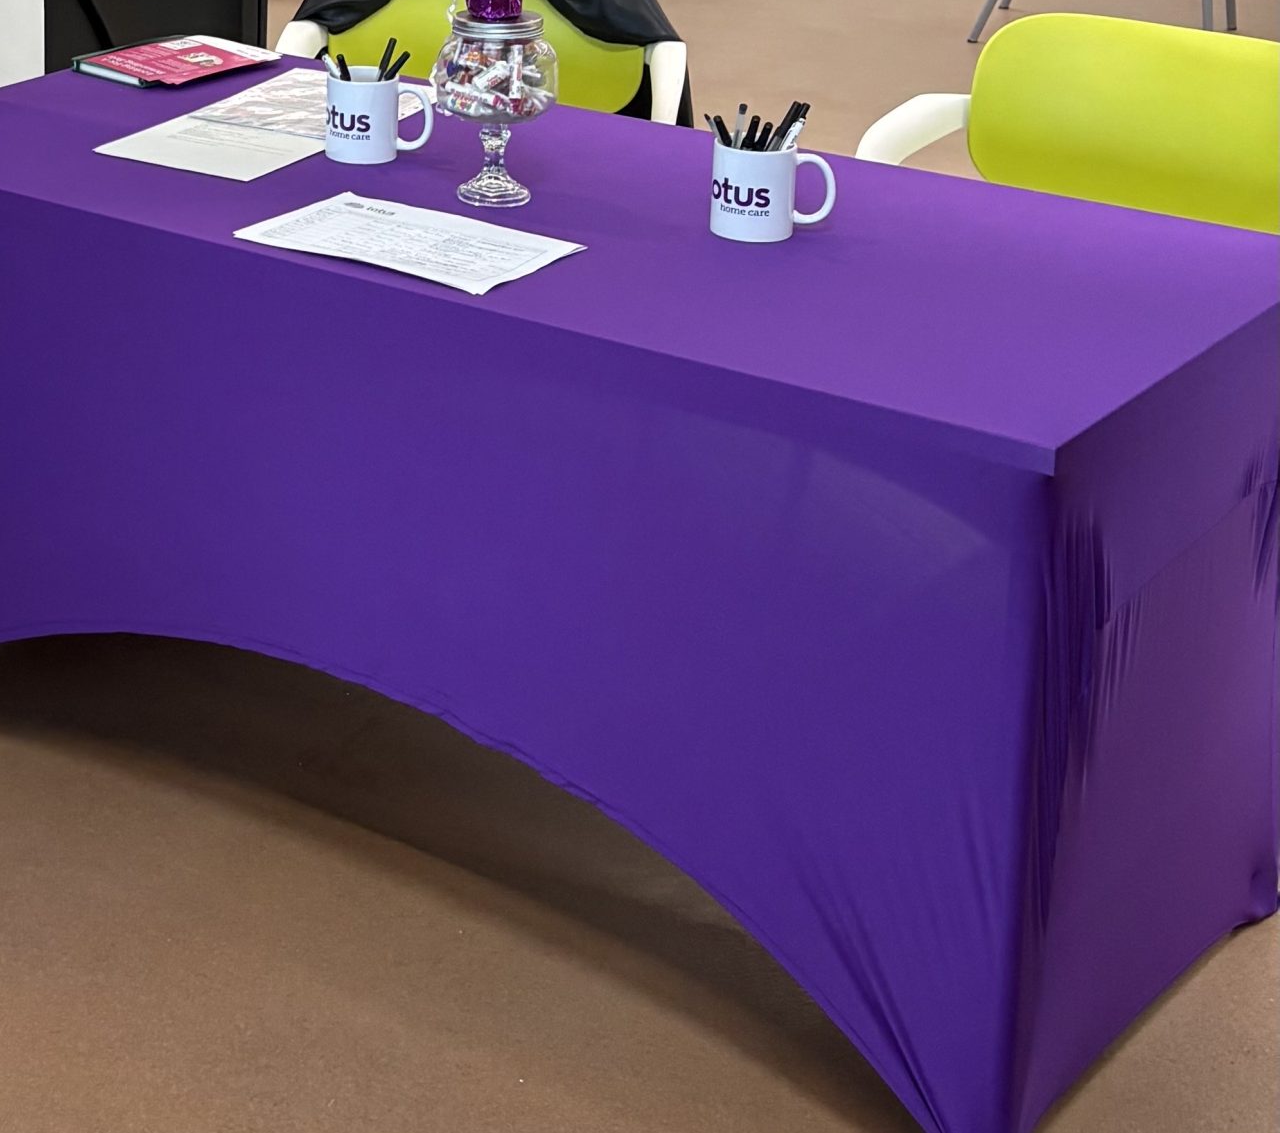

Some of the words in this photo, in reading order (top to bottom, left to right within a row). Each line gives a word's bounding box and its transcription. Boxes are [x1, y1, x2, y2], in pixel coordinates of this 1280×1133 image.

[326, 105, 371, 132] tus
[351, 133, 371, 141] care
[712, 177, 770, 208] otus
[720, 203, 746, 216] home
[748, 208, 770, 217] care
